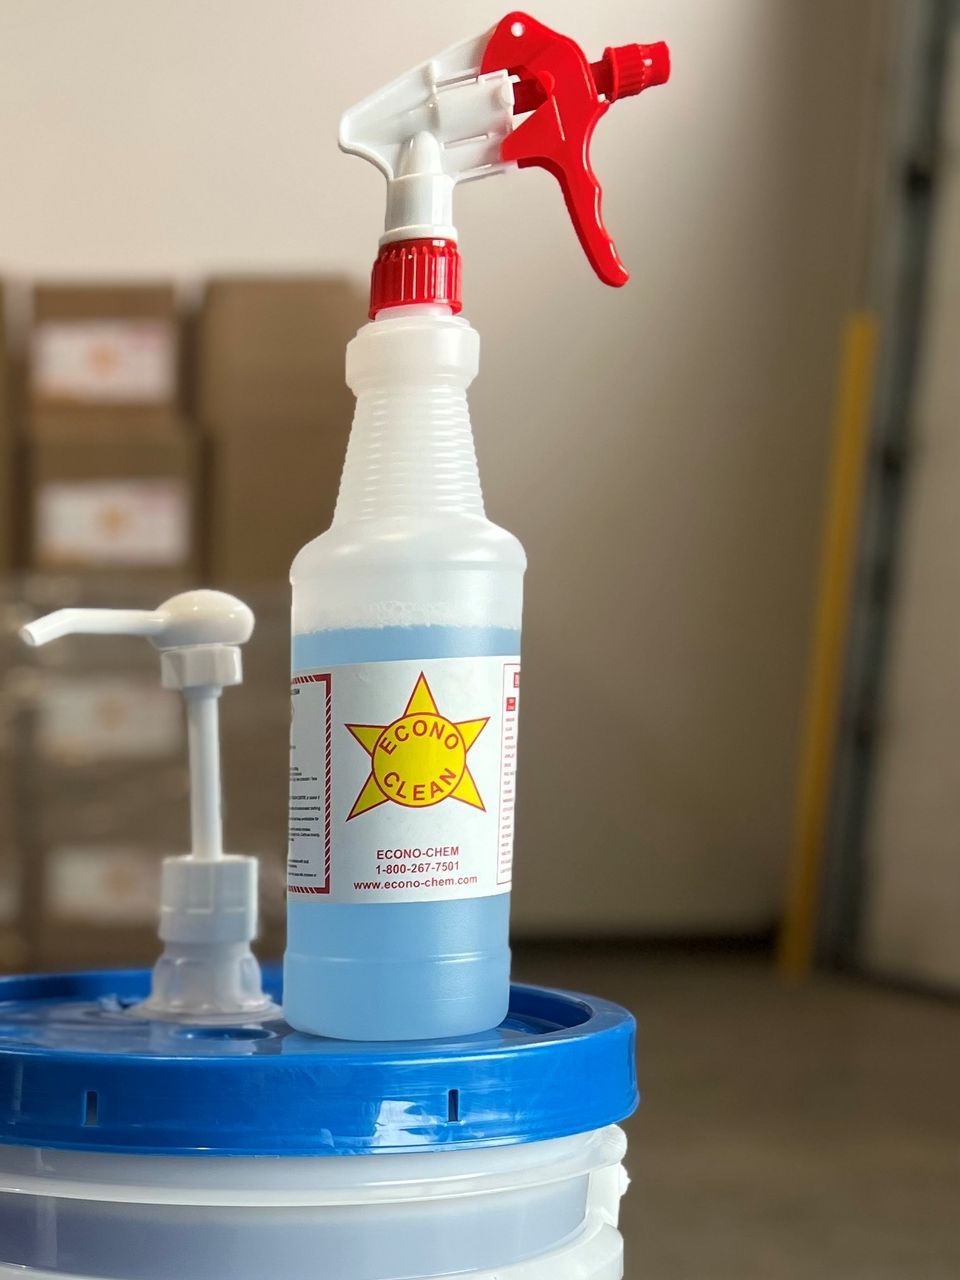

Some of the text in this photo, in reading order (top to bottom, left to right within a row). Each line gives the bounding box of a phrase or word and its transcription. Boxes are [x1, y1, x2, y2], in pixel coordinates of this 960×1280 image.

[379, 719, 459, 755] ECONO
[383, 767, 457, 801] CLEAN
[376, 846, 460, 860] ECONO-CHEM
[375, 861, 460, 875] 1-800-267-7501
[353, 875, 478, 890] www.econo-chem.com
